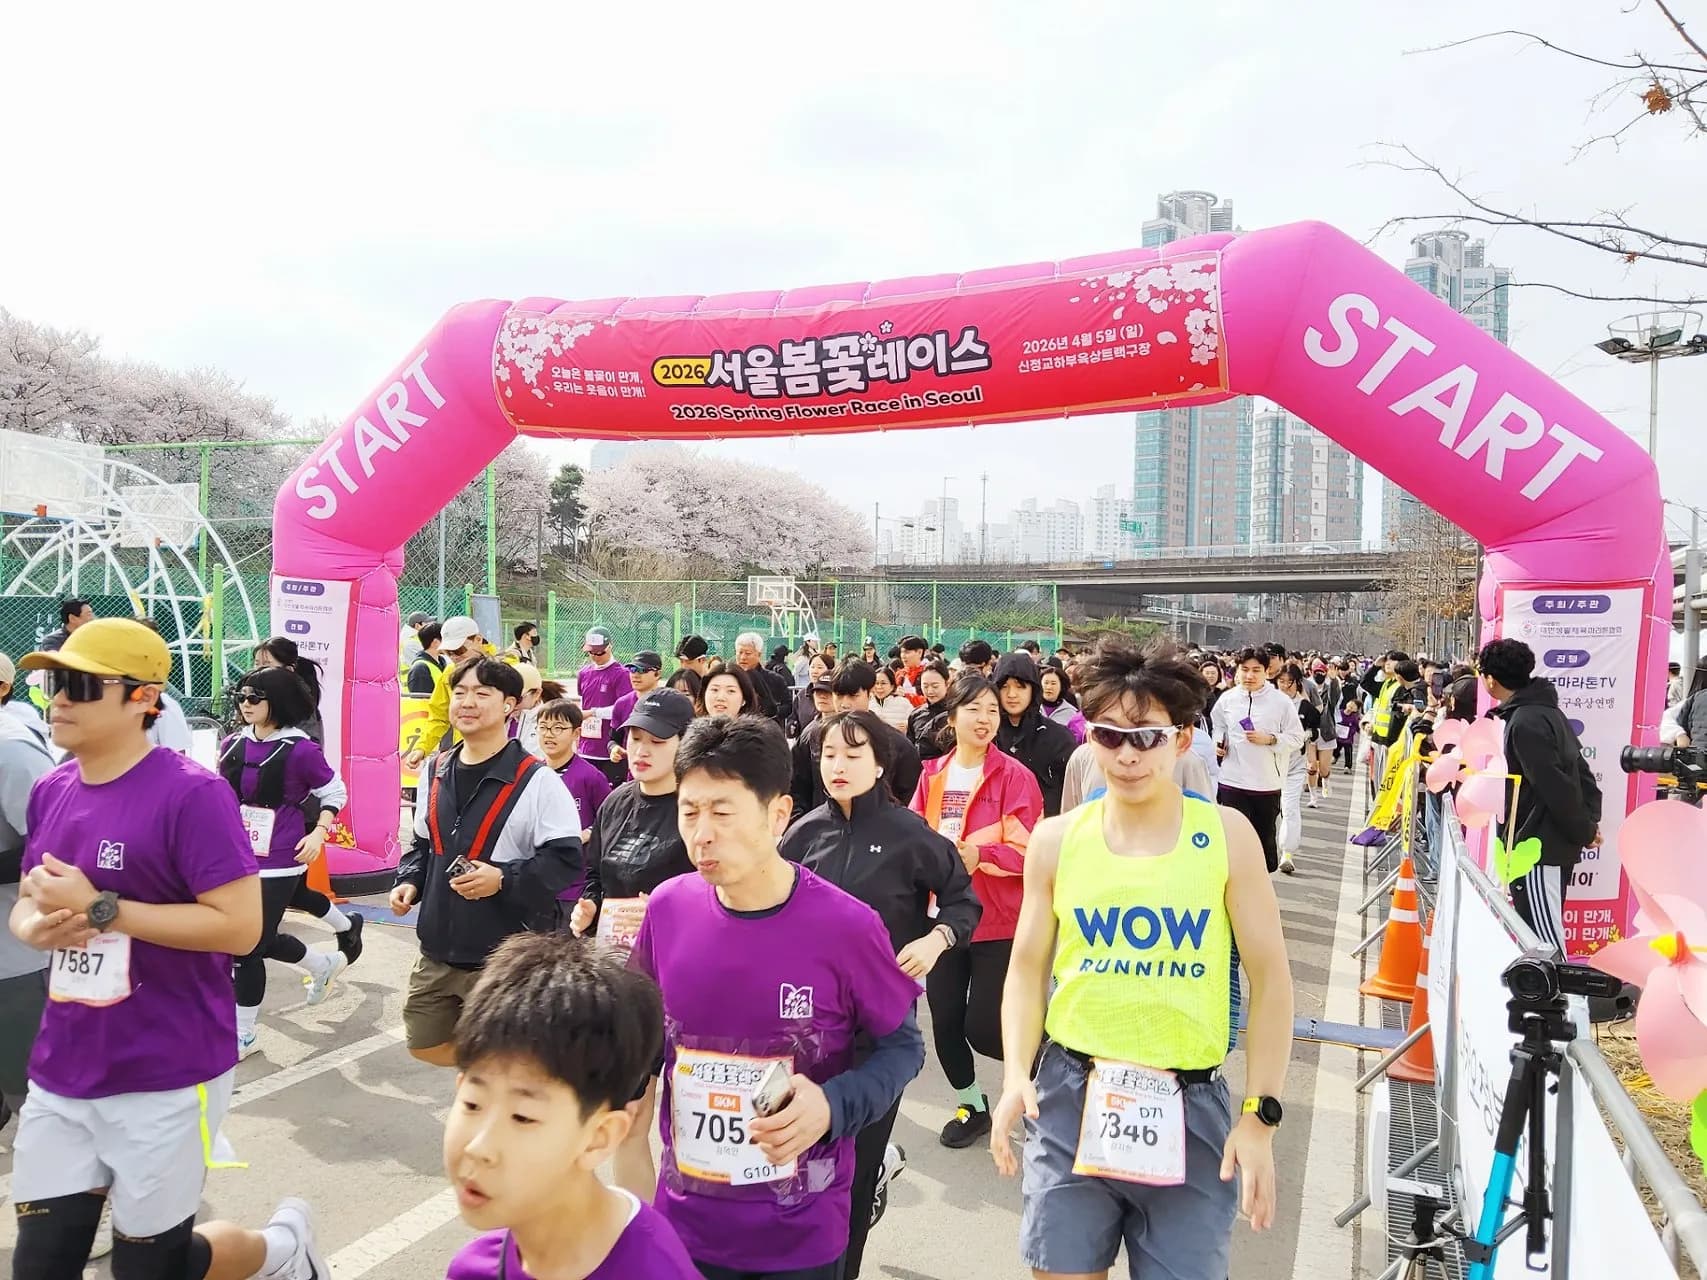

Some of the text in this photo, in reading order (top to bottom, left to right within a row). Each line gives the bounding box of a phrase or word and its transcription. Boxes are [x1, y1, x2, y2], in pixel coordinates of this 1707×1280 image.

[1022, 323, 1144, 355] 2026년 4월 5일 (일)
[660, 329, 989, 397] 2026 서울봄꽃레이스
[1018, 342, 1151, 373] 신정교하부육상트랙구장
[551, 366, 582, 381] 오늘은
[618, 371, 643, 385] 만개,
[553, 381, 584, 395] 우리는
[620, 386, 647, 398] 만개!
[673, 387, 982, 422] 2026 Spring Flower Race in Seoul
[1303, 292, 1605, 502] START
[295, 349, 447, 520] START
[1073, 905, 1212, 951] WOW
[1583, 909, 1615, 924] 만개,
[57, 948, 105, 976] 7587
[1079, 958, 1206, 978] RUNNING
[692, 1111, 759, 1145] 705
[1099, 1111, 1159, 1147] 7346
